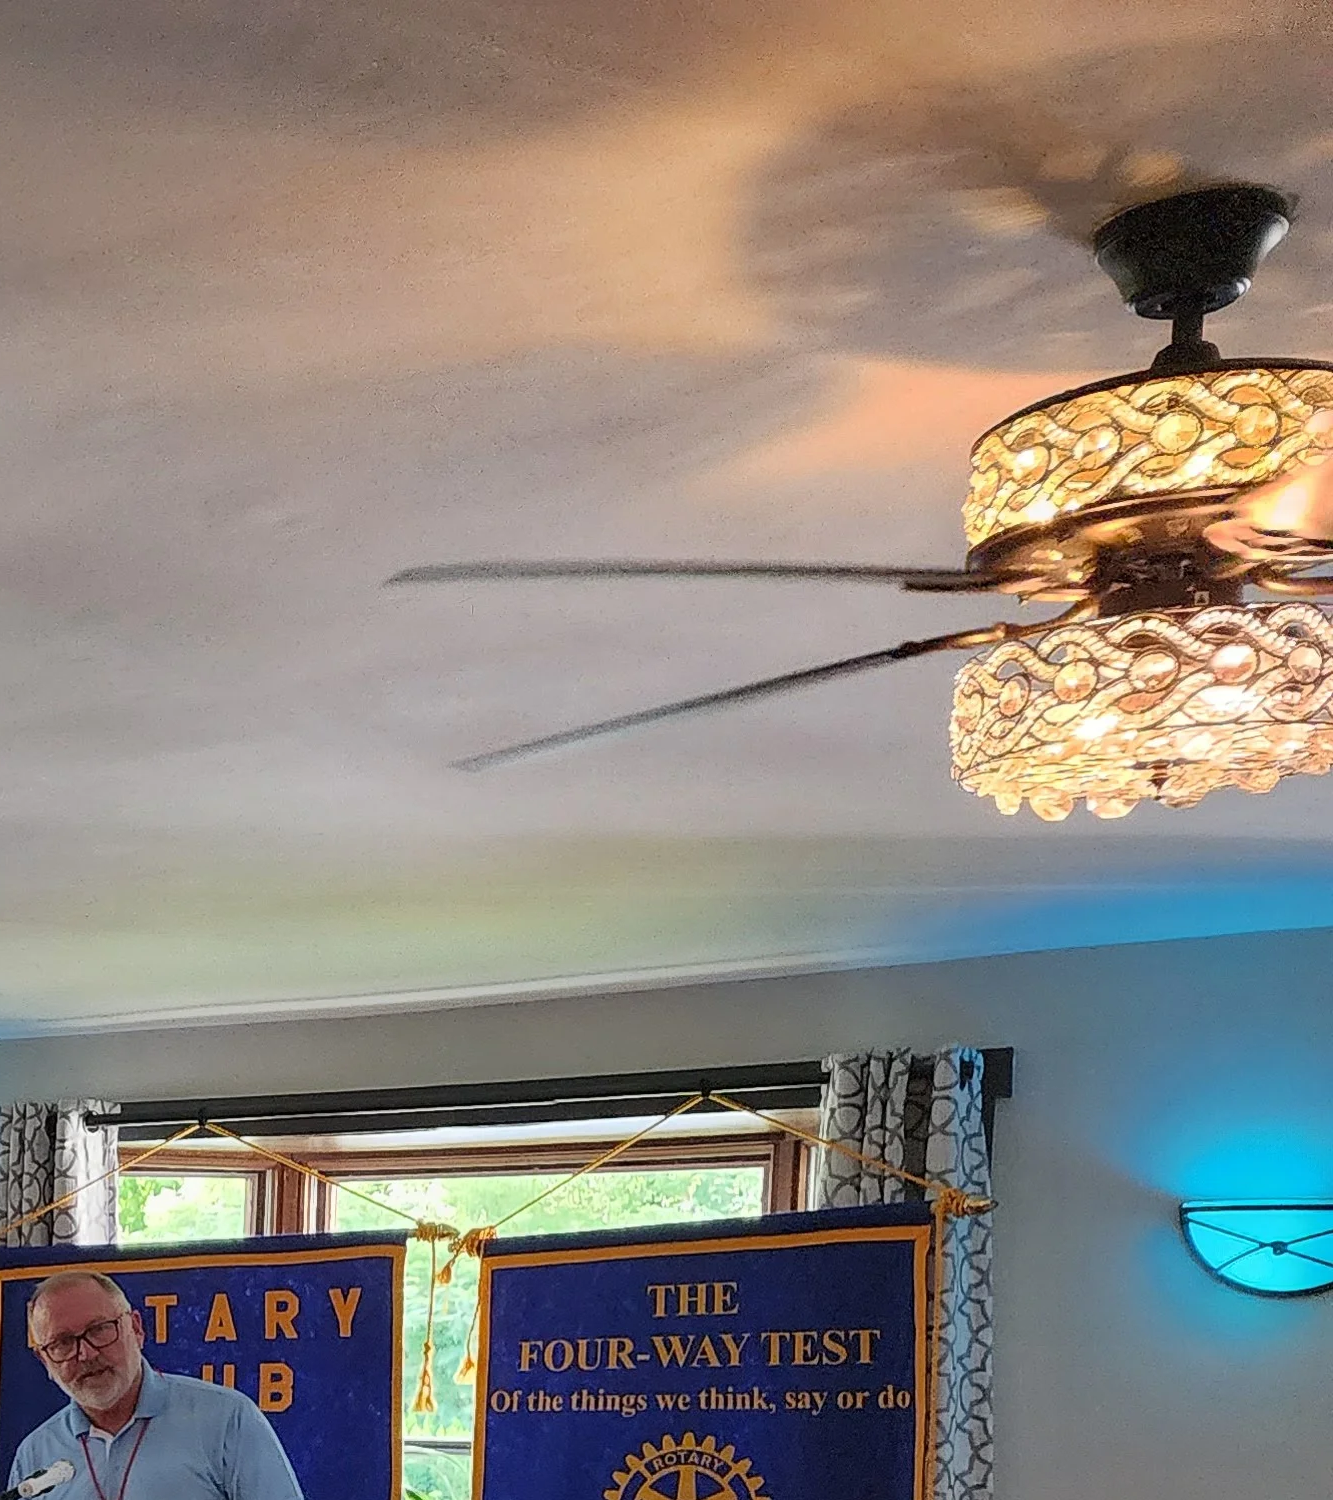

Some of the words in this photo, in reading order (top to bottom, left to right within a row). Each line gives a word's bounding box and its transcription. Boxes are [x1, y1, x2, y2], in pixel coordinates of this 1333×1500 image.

[145, 1286, 363, 1344] TARY
[647, 1281, 740, 1318] THE
[518, 1332, 750, 1373] FOUR-WAY
[760, 1329, 881, 1367] TEST
[490, 1390, 522, 1412] Of
[527, 1390, 563, 1412] the
[570, 1388, 648, 1418] things
[655, 1393, 691, 1411] we
[698, 1386, 776, 1413] think,
[785, 1389, 828, 1416] say
[836, 1390, 870, 1409] or
[877, 1384, 912, 1409] do
[652, 1451, 725, 1472] ROTARY
